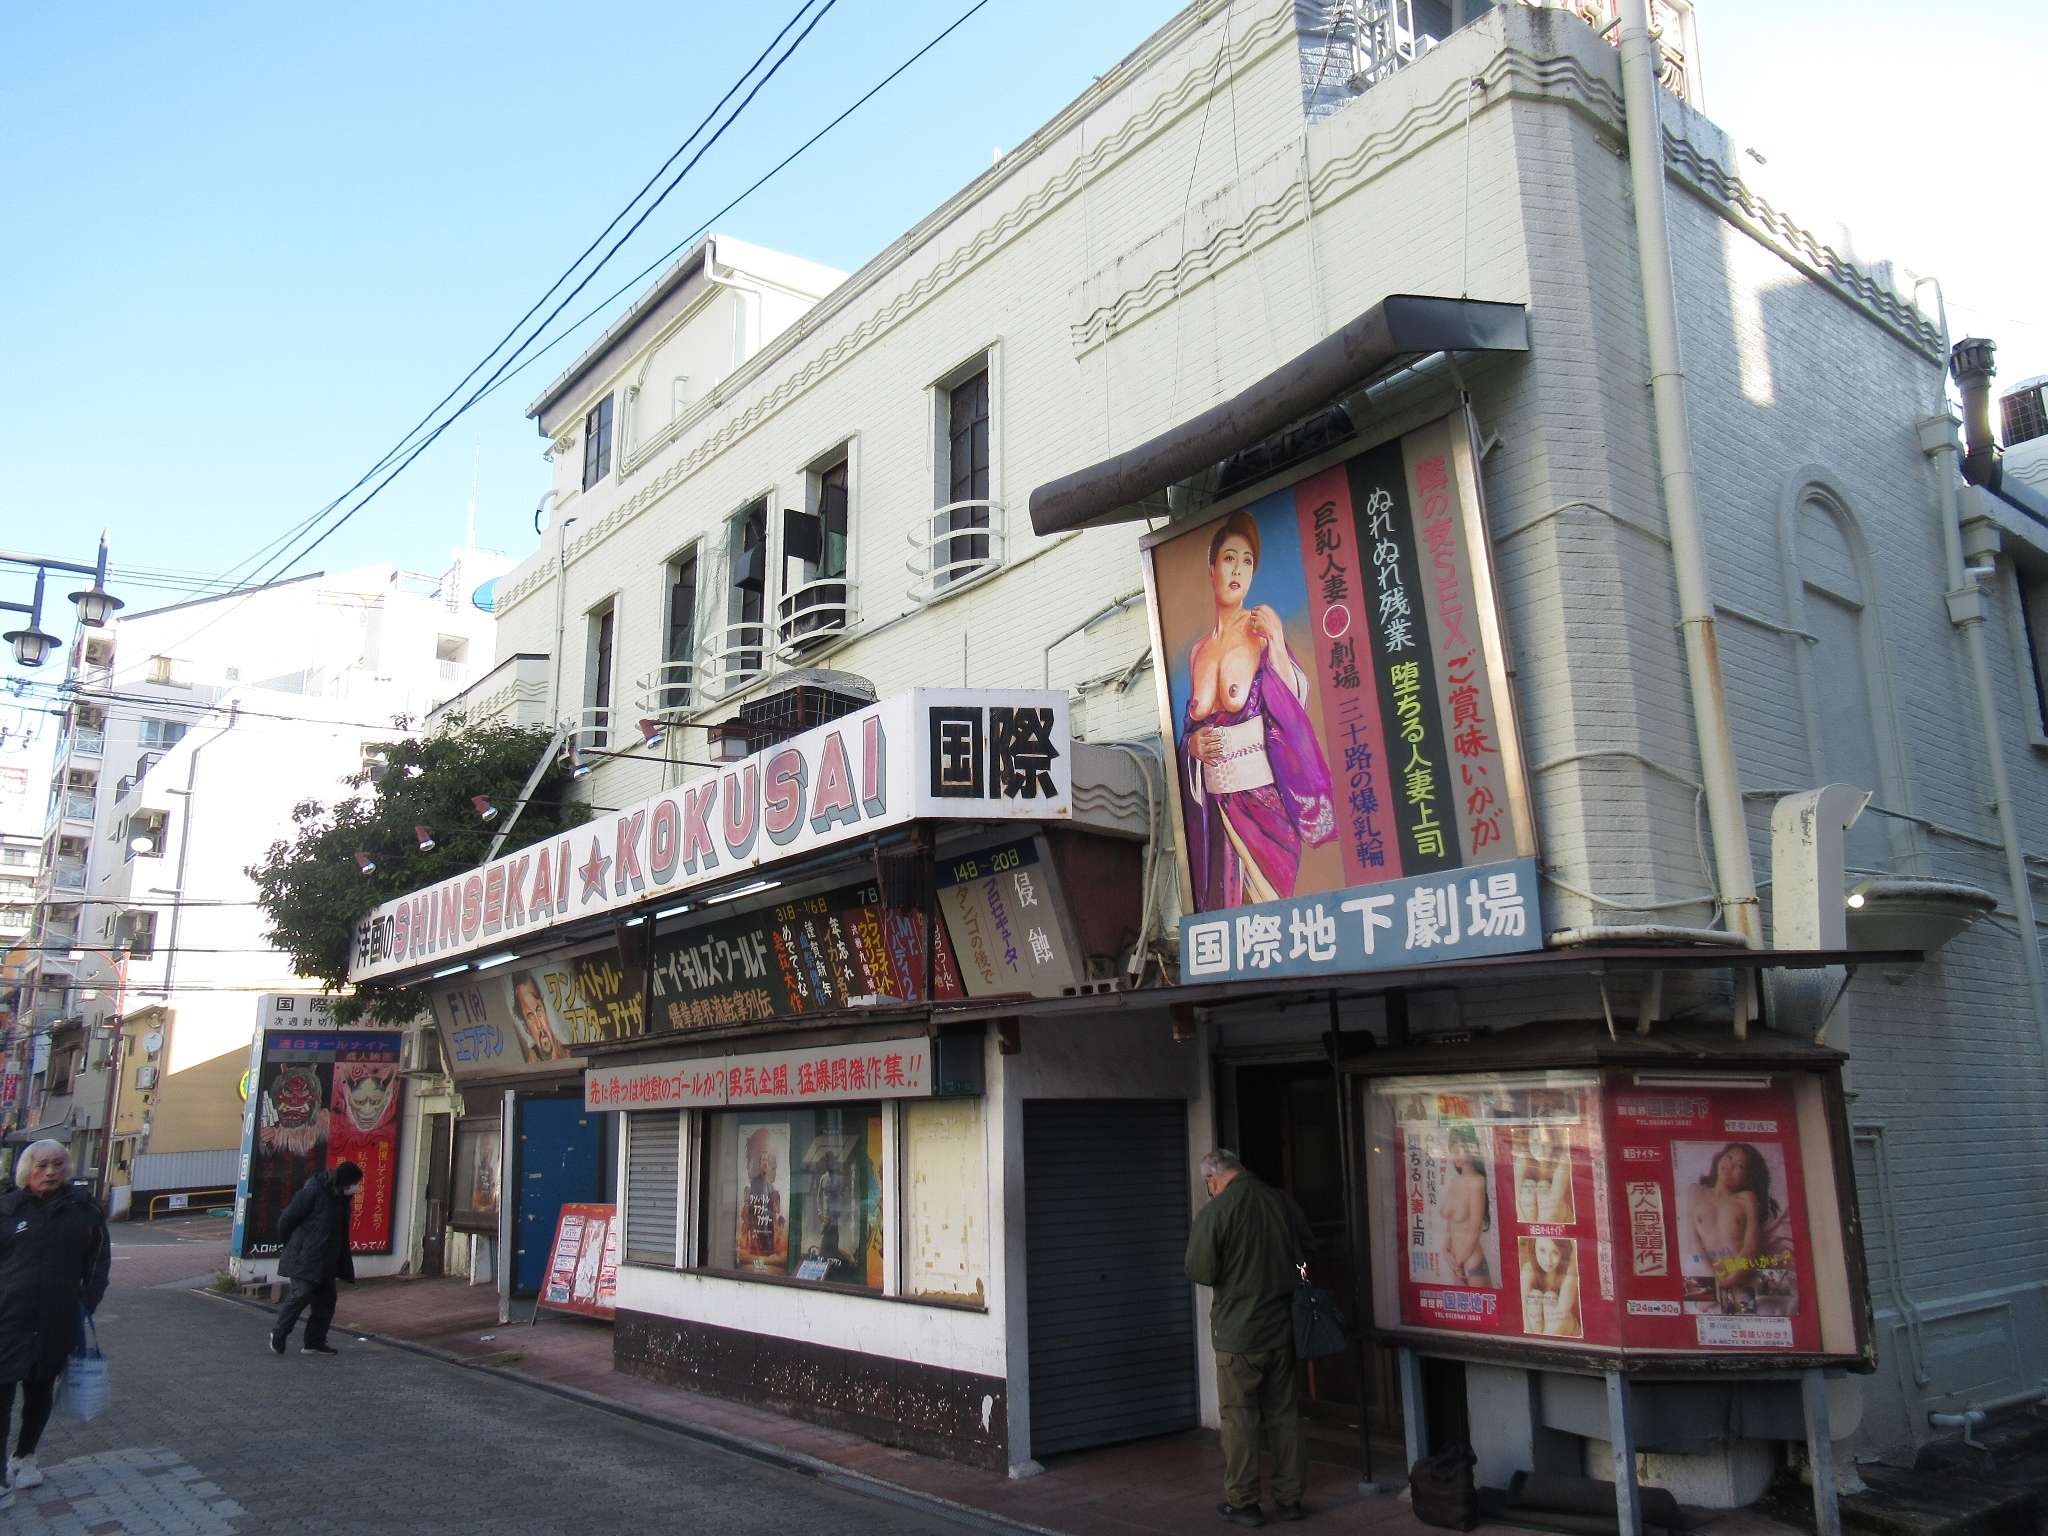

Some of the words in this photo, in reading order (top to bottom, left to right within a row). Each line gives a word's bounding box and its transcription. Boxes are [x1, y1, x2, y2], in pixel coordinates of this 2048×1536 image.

[1367, 487, 1416, 653] ぬれぬれ残業
[929, 706, 1060, 799] 国際
[1337, 697, 1385, 869] 三十路の爆乳輪
[1389, 661, 1445, 858] 堕ちる人妻上司
[1447, 649, 1504, 856] ご賞味いかが
[356, 914, 394, 969] 洋画の
[393, 840, 572, 964] SHINSEKAI
[614, 714, 887, 897] KOKUSAI
[1188, 872, 1527, 976] 国際地下劇場
[563, 991, 644, 1043] アフター・アナザ
[729, 1053, 923, 1098] 男気全開、猛爆闘傑作集!!
[590, 1070, 725, 1105] 先に待つは地獄のゴールか?
